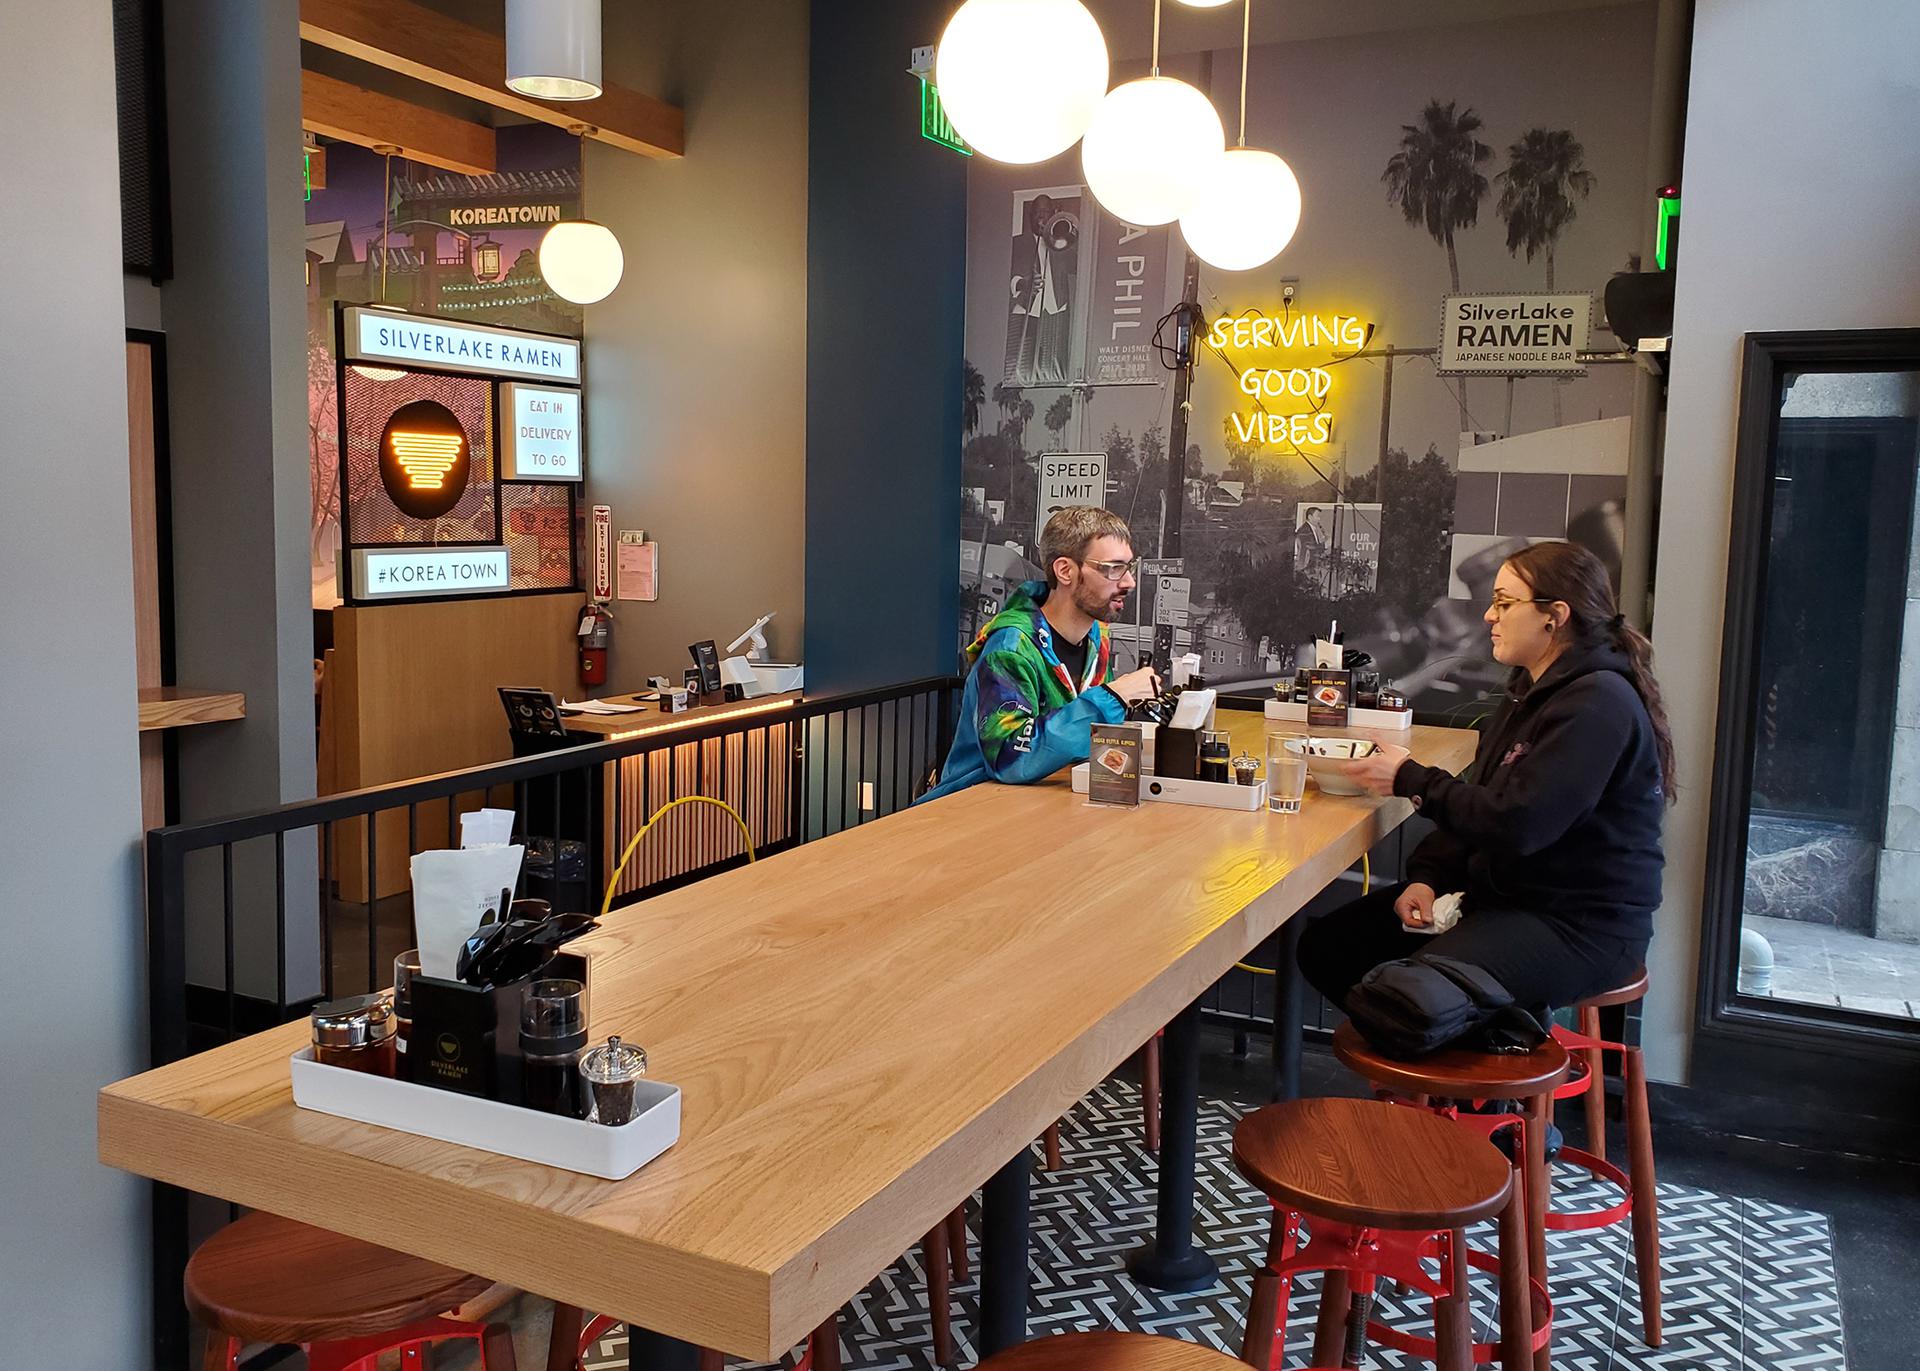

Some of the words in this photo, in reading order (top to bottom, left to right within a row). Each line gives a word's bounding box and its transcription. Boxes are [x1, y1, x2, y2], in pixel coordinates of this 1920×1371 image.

[450, 205, 561, 225] KOREATOWN
[1112, 256, 1145, 340] PHIL
[1458, 302, 1574, 321] SilverLake
[1208, 314, 1365, 350] SERVING
[1457, 324, 1573, 347] RAMEN
[379, 328, 494, 359] SILVERLAKE
[501, 344, 562, 368] RAMEN
[1099, 346, 1119, 354] WALT
[1122, 344, 1151, 353] DISNEY
[1455, 352, 1504, 362] JAPANESE
[1508, 352, 1548, 362] NOODLE
[1551, 352, 1572, 361] BAR
[1240, 367, 1333, 400] GOOD
[530, 400, 548, 413] EAT
[553, 402, 563, 414] IN
[521, 426, 572, 441] DELIVERY
[1231, 410, 1333, 445] VIBES
[532, 453, 547, 466] TO
[551, 454, 567, 467] GO
[1046, 462, 1101, 477] SPEED
[1050, 484, 1093, 498] LIMIT
[596, 514, 609, 523] FIRE
[1350, 532, 1370, 542] OUR
[1356, 542, 1378, 551] CITY
[451, 563, 498, 580] TOWN
